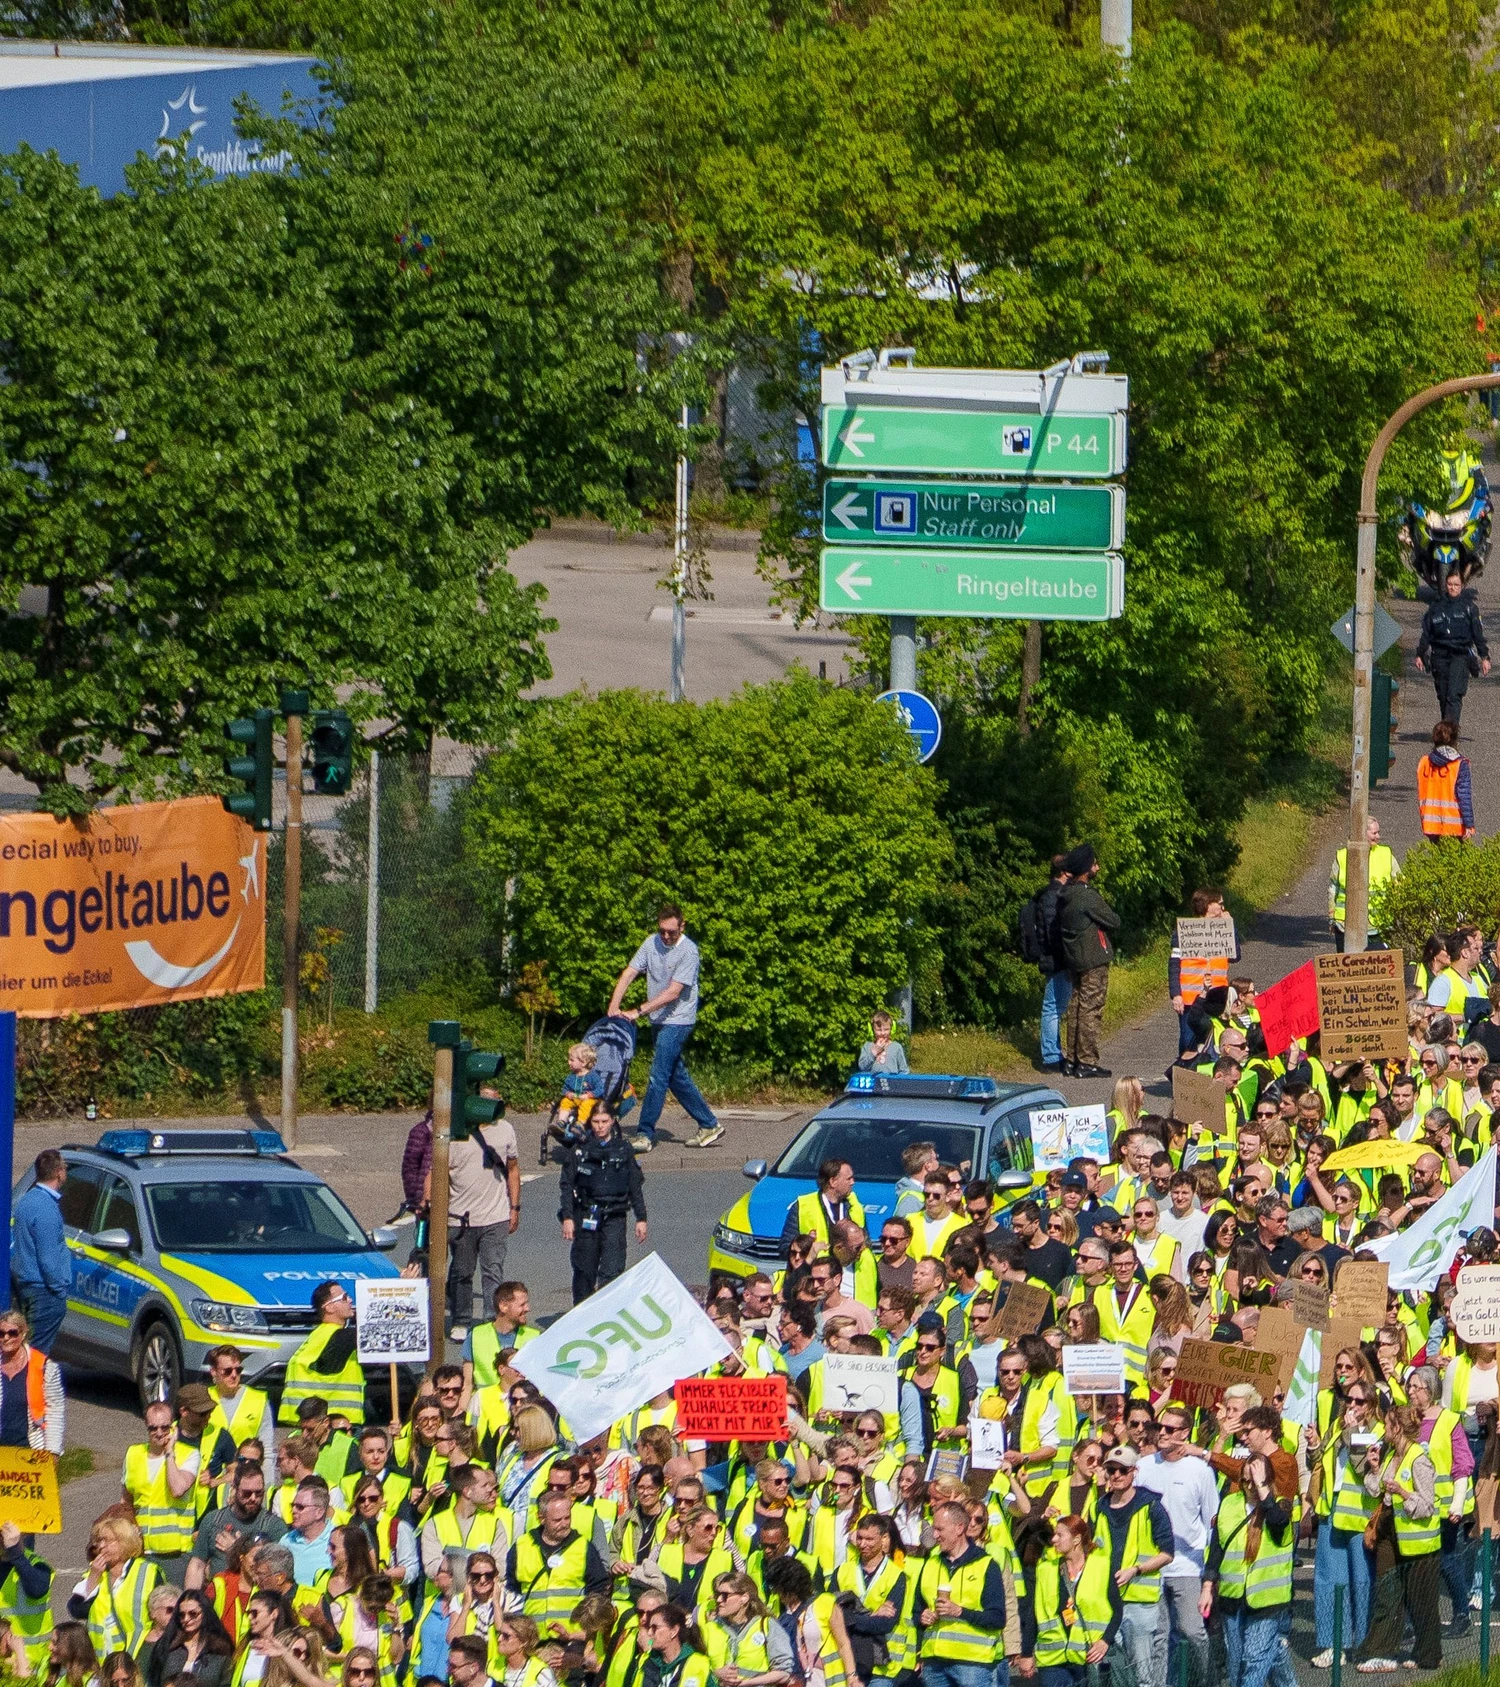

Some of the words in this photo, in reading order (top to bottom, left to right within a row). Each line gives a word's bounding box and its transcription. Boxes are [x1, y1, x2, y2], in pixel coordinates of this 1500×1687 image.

[1046, 433, 1062, 454] P
[1066, 434, 1100, 456] 44
[923, 492, 961, 512] Nur
[967, 494, 1056, 515] Personal
[923, 516, 977, 538] Staff
[981, 522, 1027, 543] only
[956, 574, 1098, 600] Ringeltaube
[0, 839, 57, 860] ecial
[64, 839, 94, 861] way
[99, 837, 112, 853] to
[114, 834, 142, 857] buy.
[0, 861, 231, 955] ngeltaube
[1181, 940, 1203, 948] Kabine
[1319, 957, 1340, 968] Erst
[31, 976, 58, 990] um
[62, 974, 81, 988] die
[1321, 986, 1342, 996] Keine
[1344, 984, 1397, 994] Vollzeitstellen
[1322, 998, 1337, 1006] bei
[1323, 1018, 1344, 1029] Ein
[1327, 1045, 1353, 1055] dabei
[1361, 1043, 1385, 1053] denkt
[1038, 1112, 1070, 1124] KRAN-
[1075, 1117, 1091, 1127] ICH
[1461, 1273, 1472, 1285] Es
[1474, 1275, 1488, 1283] war
[76, 1271, 121, 1305] POLIZEI
[1455, 1311, 1473, 1322] Kein
[1475, 1308, 1499, 1320] Gold
[826, 1356, 843, 1371] WIR
[1217, 1345, 1278, 1376] GIER
[680, 1383, 715, 1399] IMMER
[682, 1399, 738, 1415] ZUHAUSE
[685, 1416, 720, 1432] NICHT
[723, 1415, 746, 1430] MIT
[751, 1415, 775, 1431] MIR
[0, 1484, 46, 1501] BESSER
